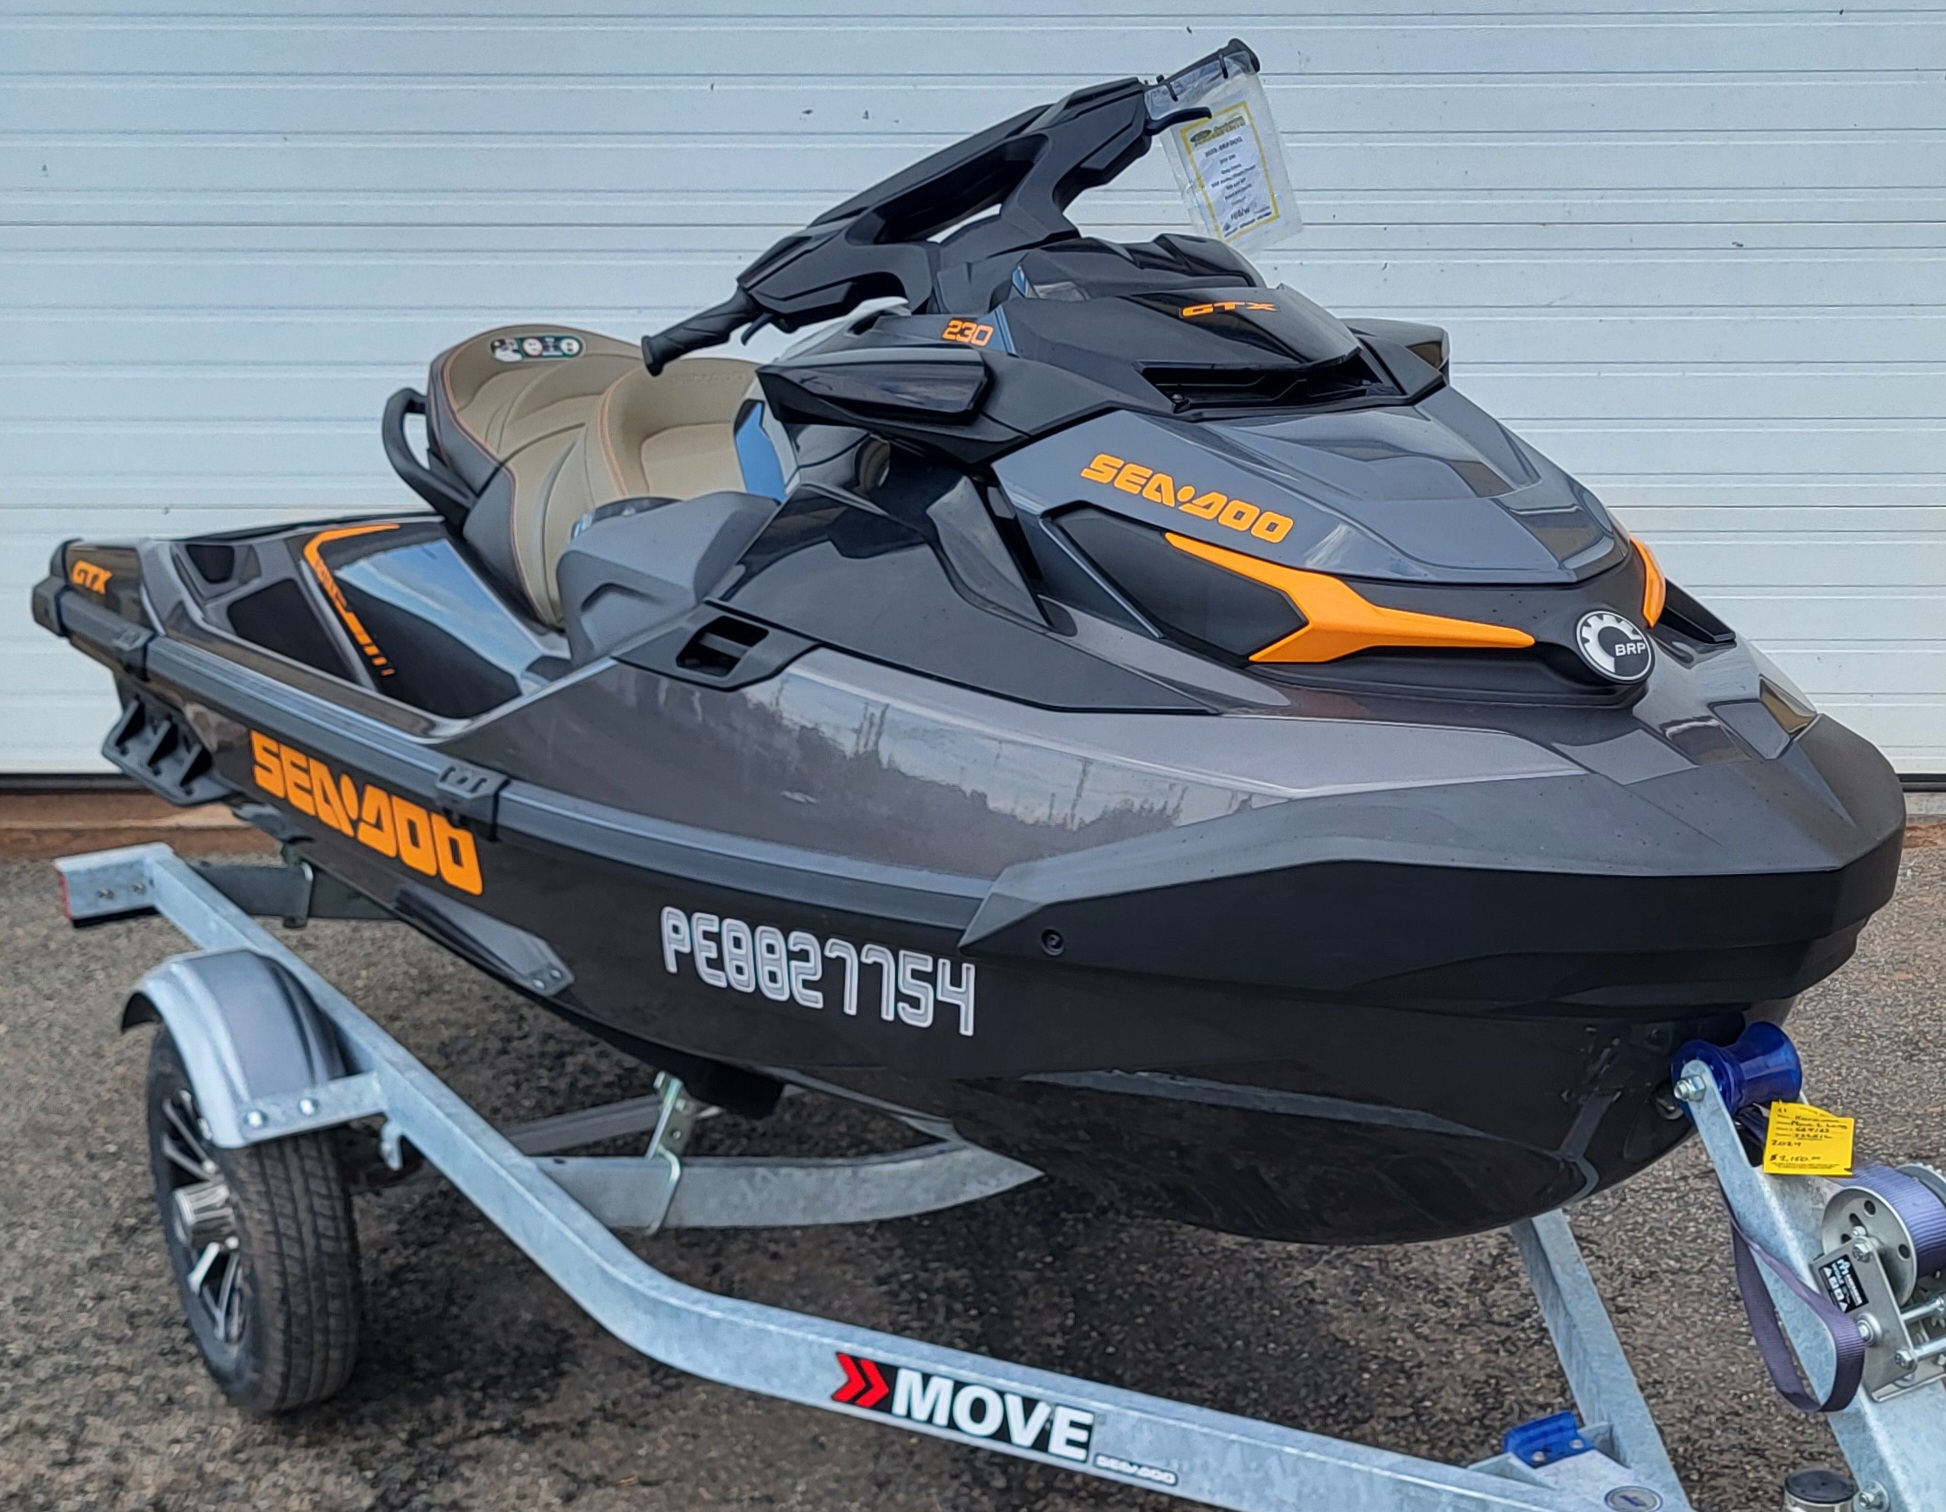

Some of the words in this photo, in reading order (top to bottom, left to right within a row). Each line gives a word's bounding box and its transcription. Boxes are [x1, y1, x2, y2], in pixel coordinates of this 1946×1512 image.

[1183, 301, 1277, 317] GTX
[942, 319, 994, 346] 230
[70, 560, 112, 595] GTX
[1615, 642, 1647, 656] BRP
[661, 906, 975, 1036] PE8827754
[891, 1368, 1095, 1461] MOVE
